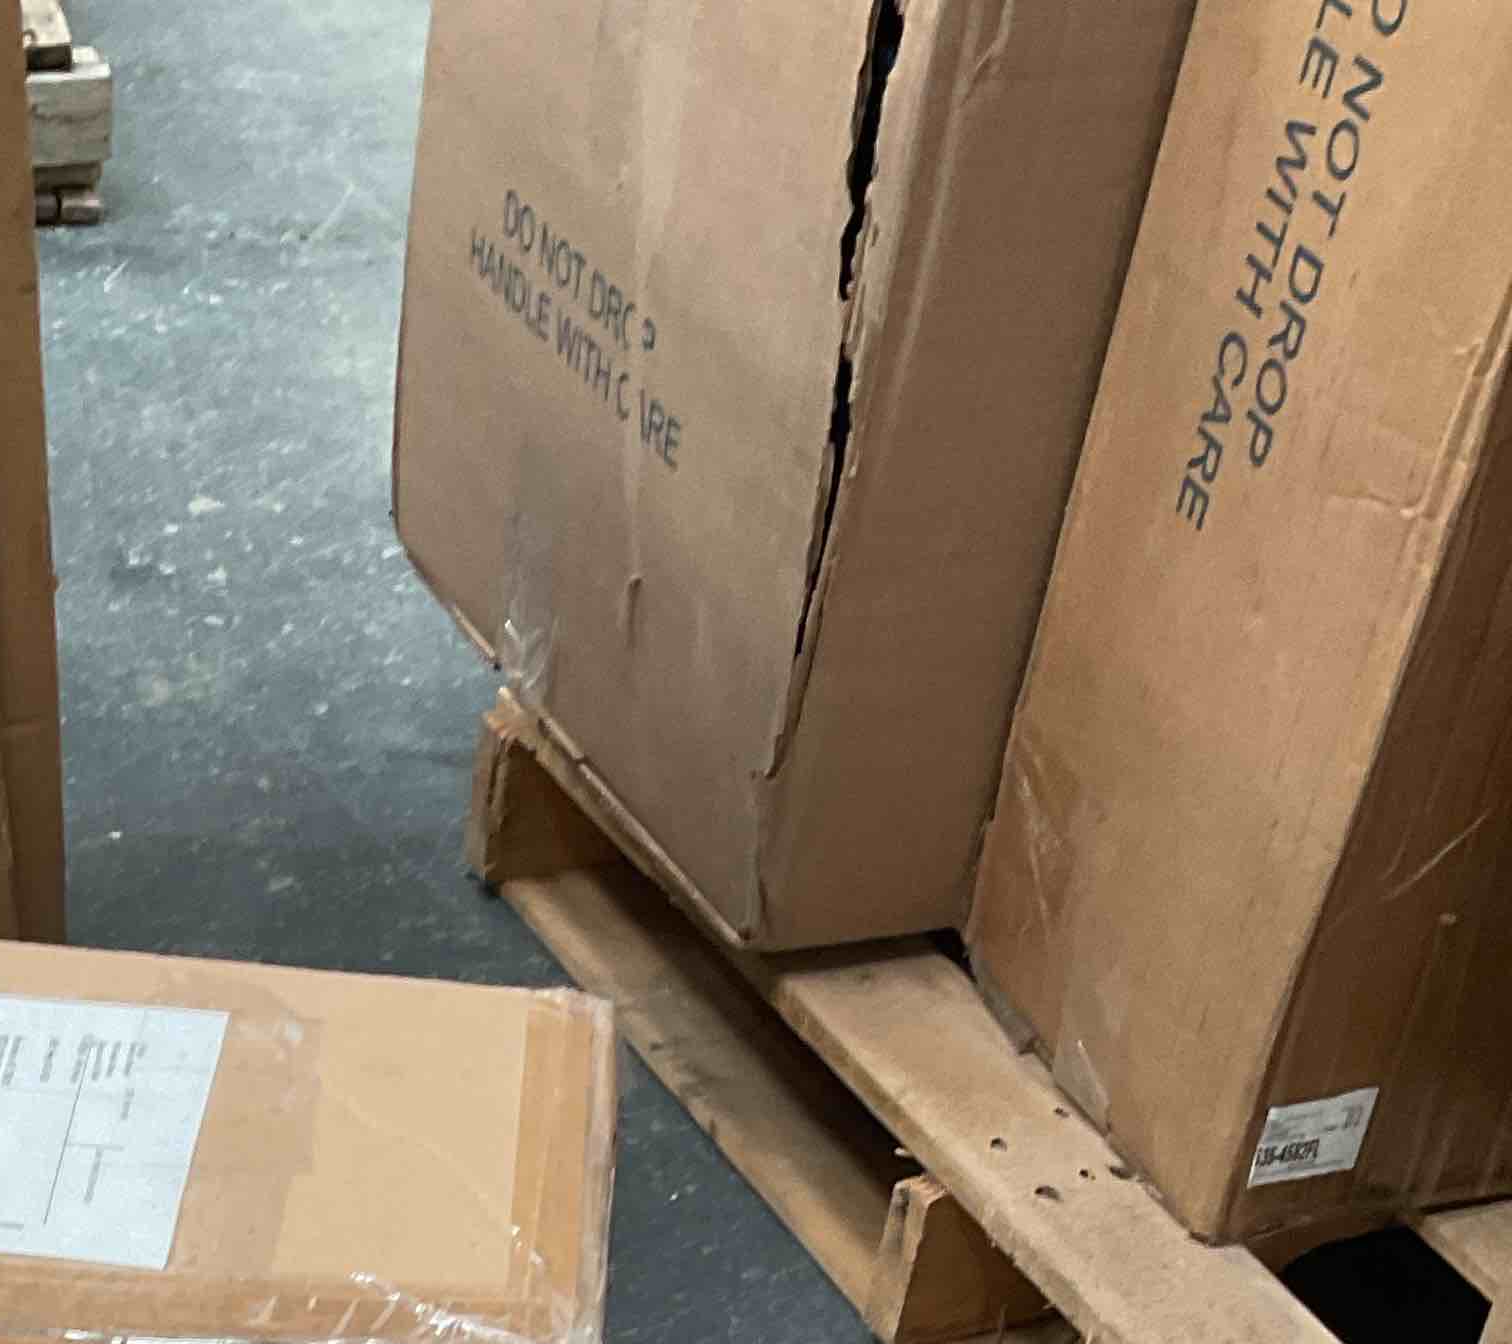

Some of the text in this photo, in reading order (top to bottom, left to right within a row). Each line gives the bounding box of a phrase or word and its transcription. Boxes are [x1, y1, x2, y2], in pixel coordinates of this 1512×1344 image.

[1236, 122, 1316, 318] WITH
[1312, 55, 1384, 240] NOT
[470, 227, 552, 342] HANDLE
[557, 308, 611, 402] WITH
[504, 189, 535, 252] DO
[540, 222, 586, 300] NOT
[1176, 332, 1248, 530] CARE
[1246, 245, 1324, 467] DROP
